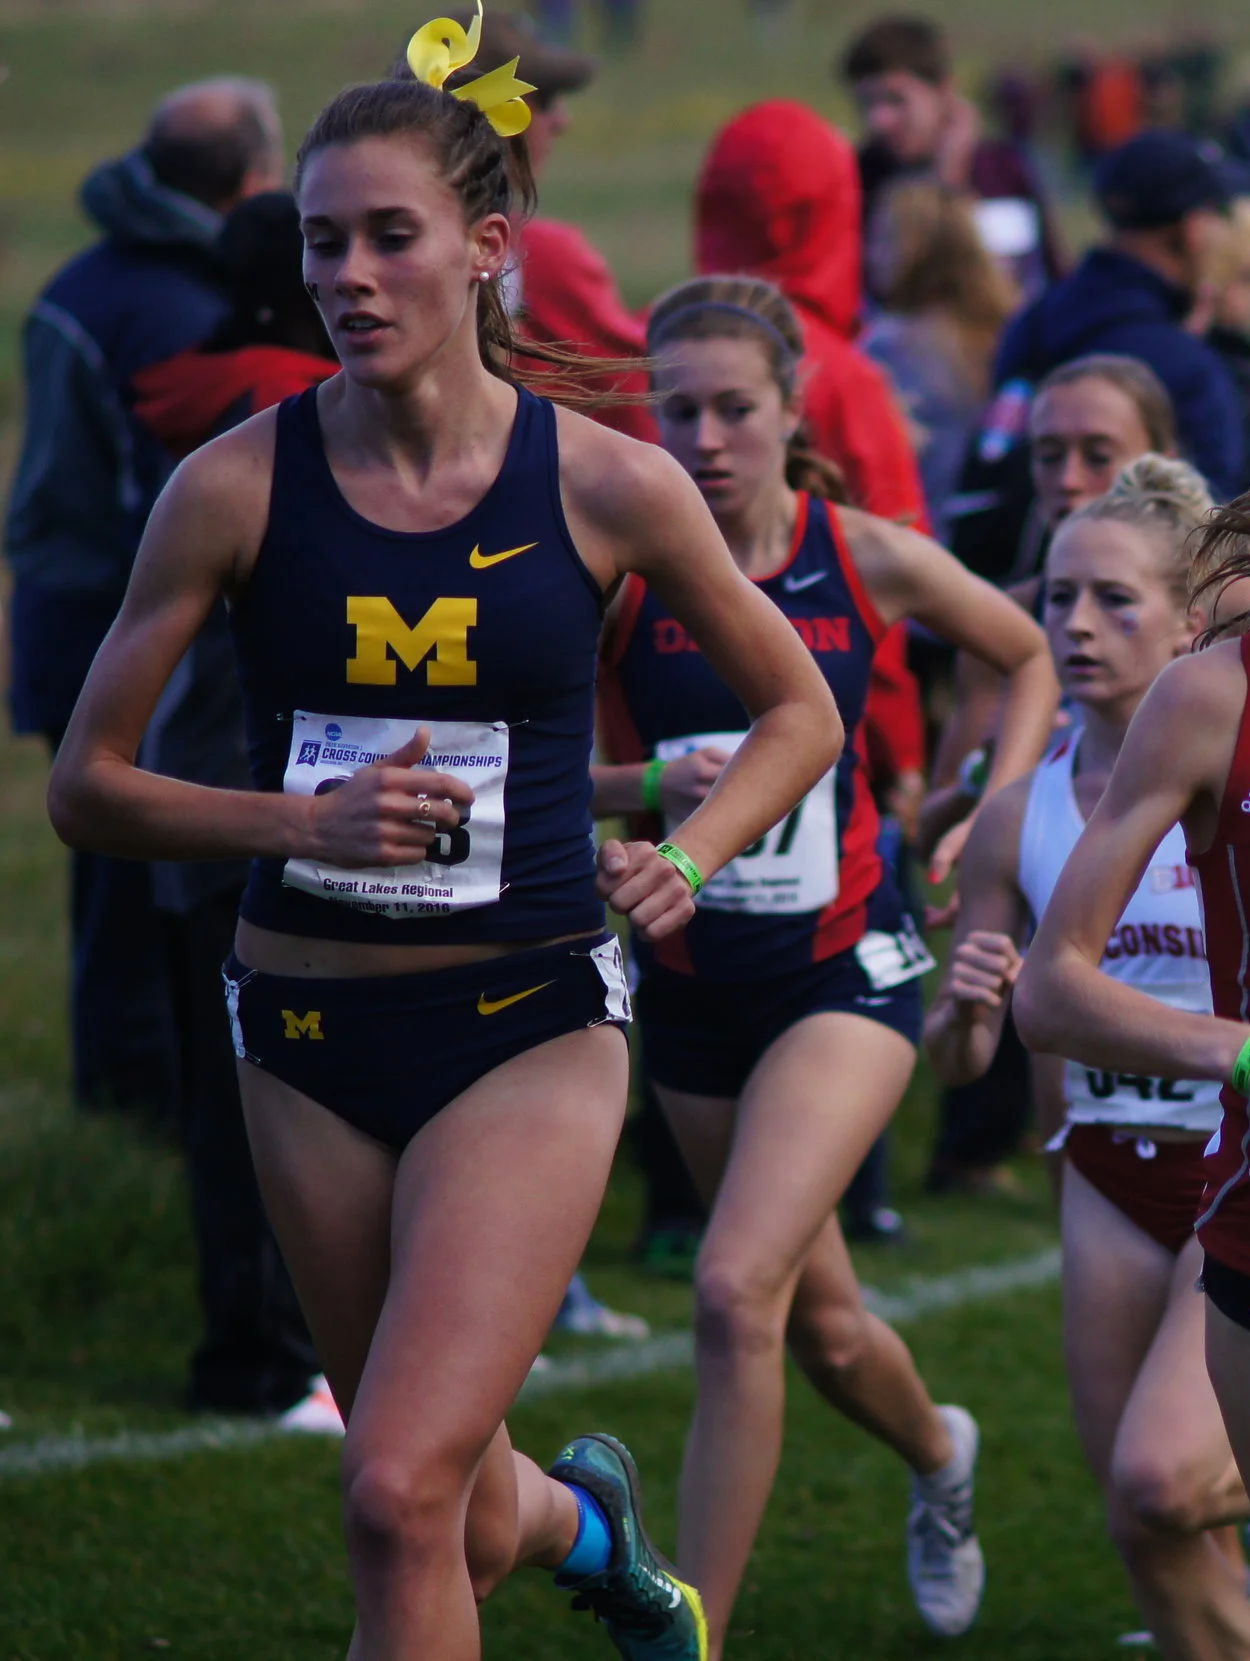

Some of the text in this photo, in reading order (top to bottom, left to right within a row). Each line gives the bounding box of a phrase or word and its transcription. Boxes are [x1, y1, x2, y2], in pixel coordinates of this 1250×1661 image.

[346, 596, 478, 686] M
[652, 616, 852, 654] DON
[321, 747, 357, 762] CROSS
[419, 755, 502, 767] HAMPIONSHIPS
[323, 878, 453, 898] Great Lakes Regional
[1105, 923, 1206, 959] CONSI
[282, 1010, 324, 1039] M
